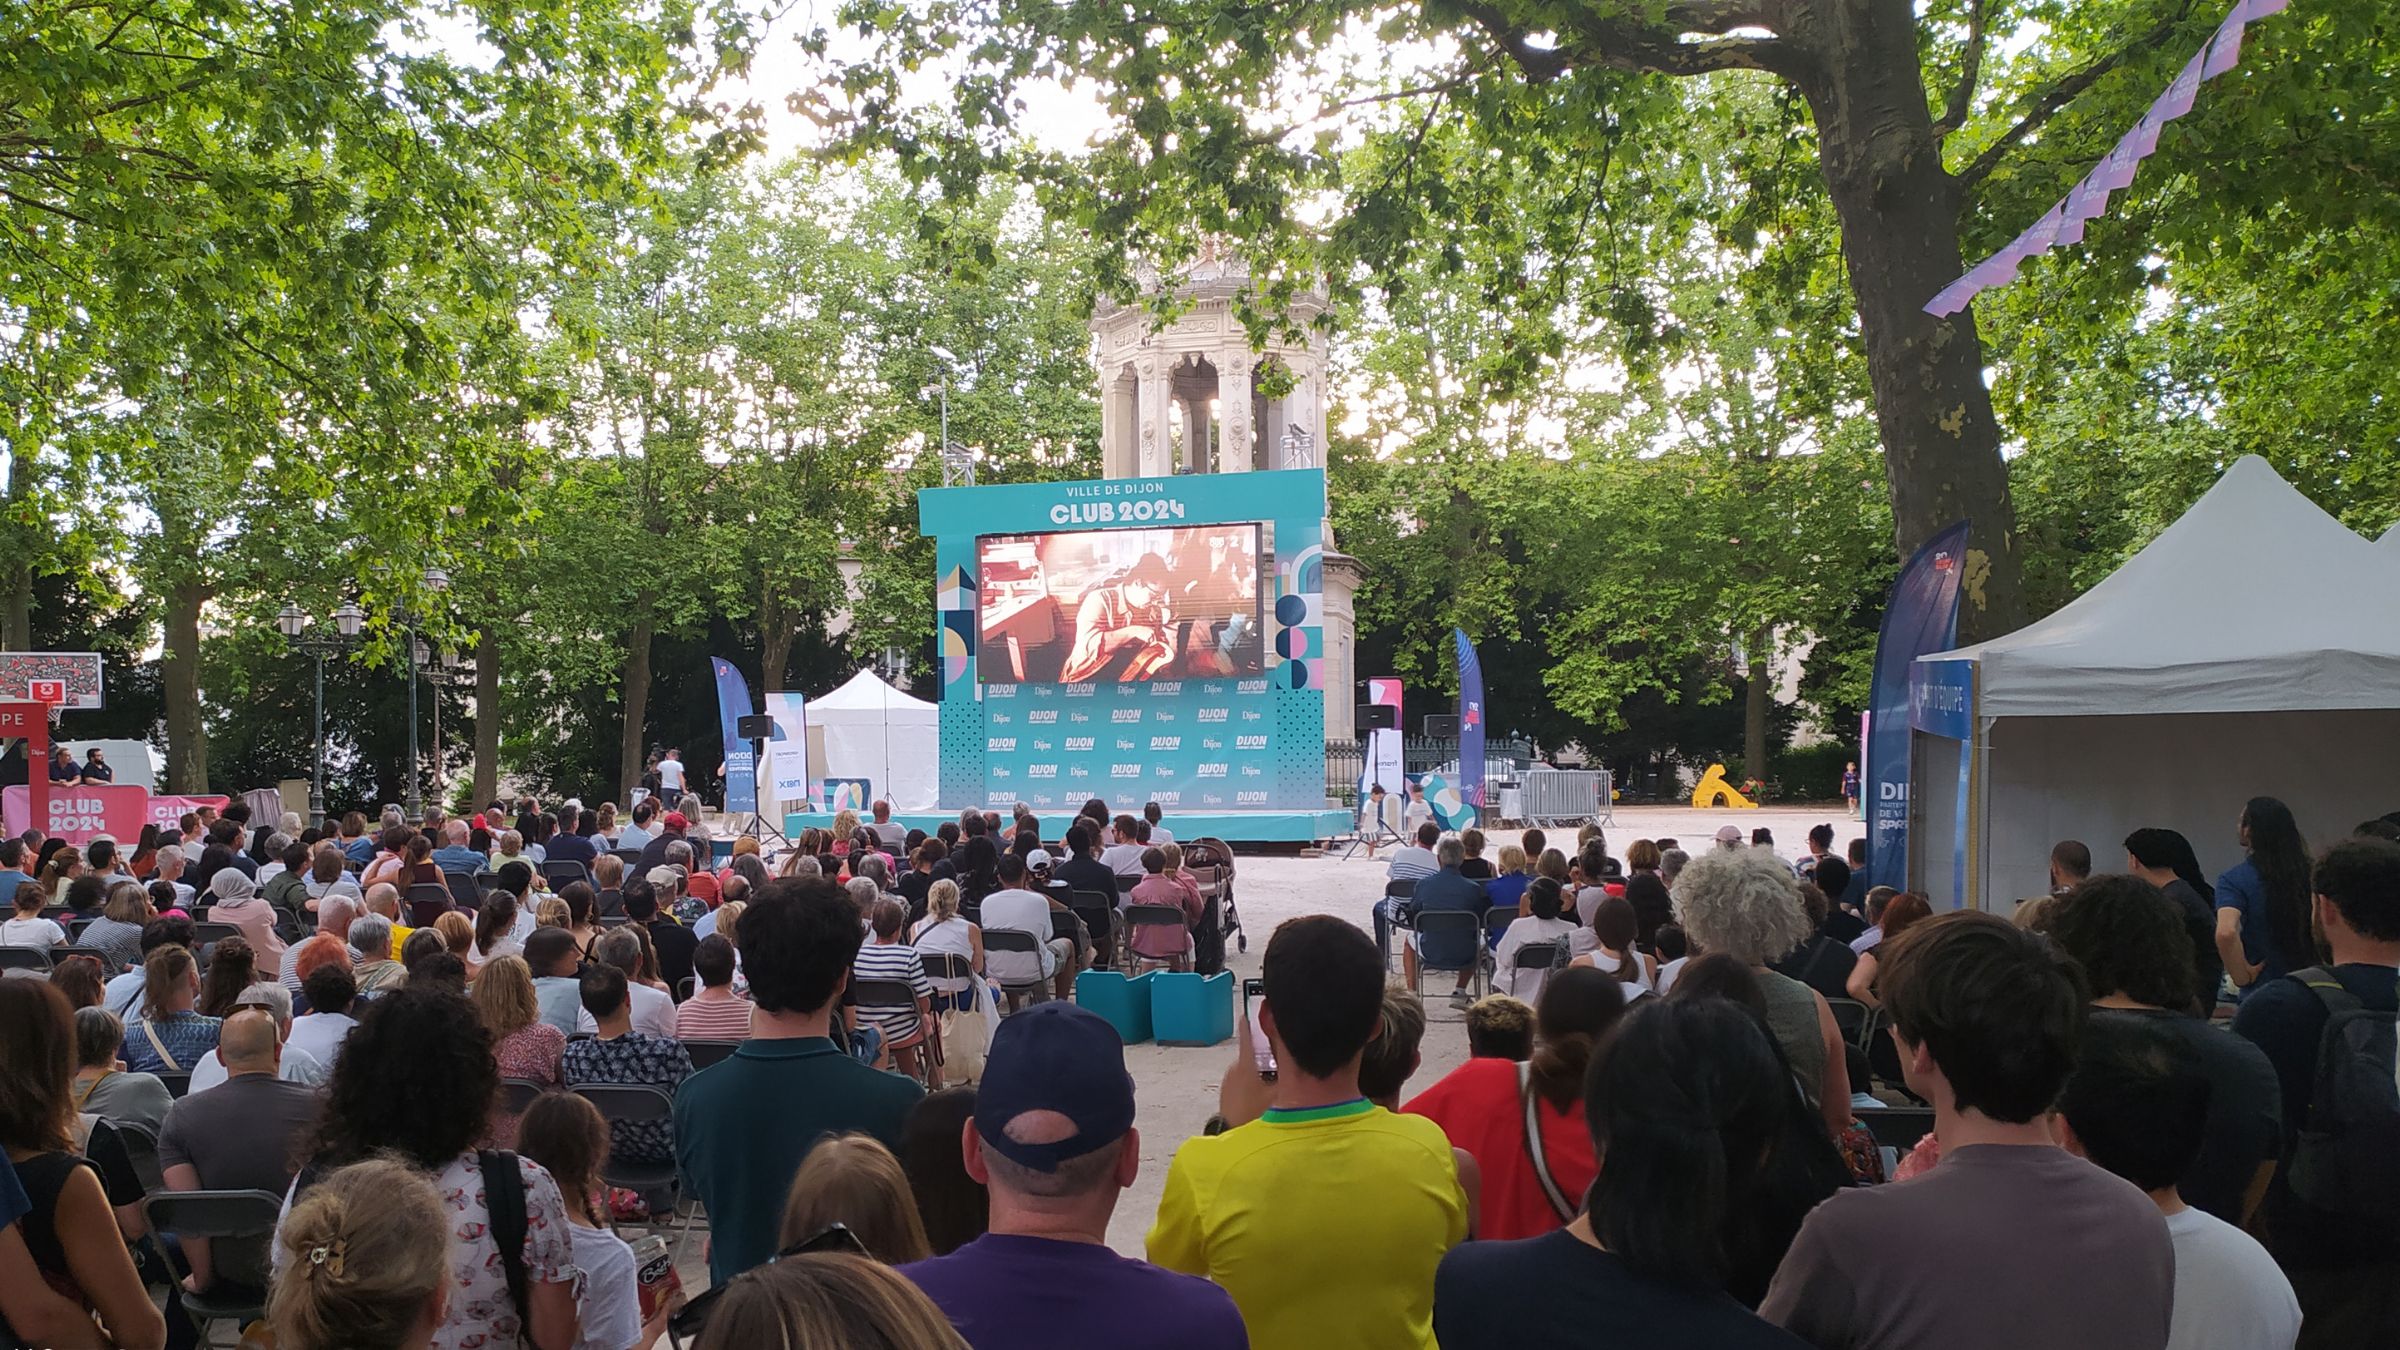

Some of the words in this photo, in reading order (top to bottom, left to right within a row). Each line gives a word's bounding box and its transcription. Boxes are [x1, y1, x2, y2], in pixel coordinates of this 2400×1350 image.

[1066, 486, 1100, 497] VILLE
[1105, 485, 1120, 495] DE
[1125, 483, 1163, 494] DIJON
[1050, 502, 1115, 525] CLUB
[1118, 499, 1185, 521] 2024
[988, 684, 1017, 694] DIJON
[1066, 683, 1096, 692] DIJON
[1151, 682, 1182, 692] DIJON
[1204, 684, 1222, 694] Dijon
[1237, 680, 1268, 690] DIJON
[1034, 686, 1052, 696] Dijon
[1117, 686, 1136, 696] Dijon
[1029, 710, 1058, 720] DIJON
[1071, 712, 1089, 722] Dijon
[1112, 710, 1141, 719] DIJON
[1156, 712, 1174, 722] Dijon
[1198, 708, 1229, 718] DIJON
[1242, 711, 1260, 721] Dijon
[993, 714, 1011, 724] Dijon
[988, 738, 1016, 748] DIJON
[1034, 740, 1052, 750] Dijon
[1065, 738, 1095, 747] DIJON
[1116, 740, 1135, 750] Dijon
[1150, 736, 1181, 746] DIJON
[1203, 739, 1222, 749] Dijon
[1236, 736, 1267, 746] DIJON
[993, 767, 1010, 777] Dijon
[1029, 764, 1058, 774] DIJON
[1070, 767, 1088, 778] Dijon
[1112, 764, 1140, 774] DIJON
[1156, 766, 1174, 777] Dijon
[1198, 764, 1228, 774] DIJON
[1242, 766, 1260, 776] Dijon
[988, 792, 1016, 802] DIJON
[1066, 792, 1094, 802] DIJON
[1150, 792, 1180, 802] DIJON
[1237, 792, 1268, 802] DIJON
[48, 799, 105, 814] CLUB
[48, 816, 106, 832] 2024
